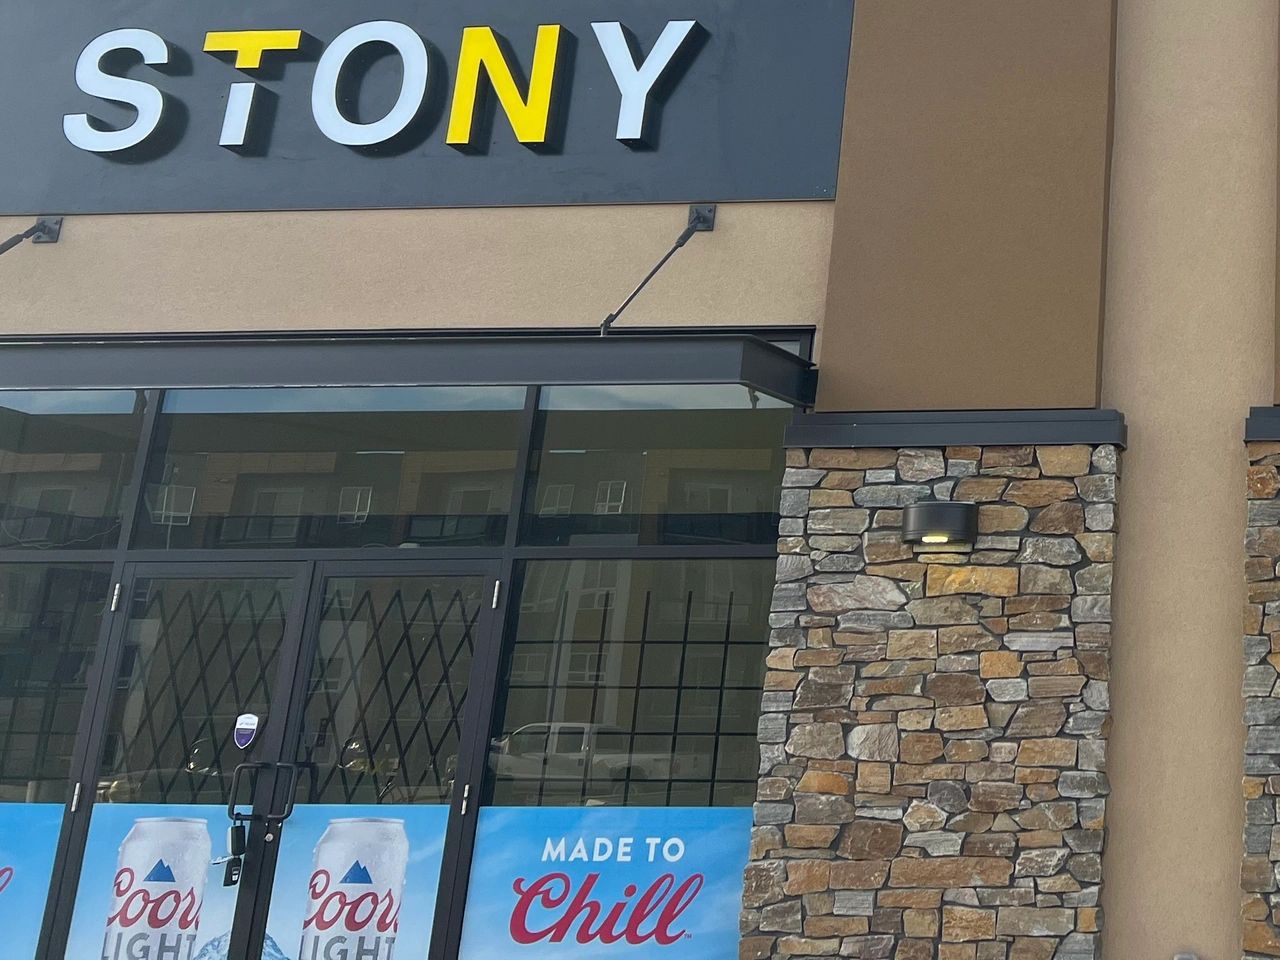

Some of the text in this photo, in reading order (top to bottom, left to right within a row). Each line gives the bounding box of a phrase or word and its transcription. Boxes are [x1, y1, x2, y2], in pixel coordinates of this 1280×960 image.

[62, 19, 704, 154] STONY
[541, 837, 685, 862] MADE TO
[107, 867, 203, 931] Coor
[303, 869, 402, 933] Coor
[509, 872, 705, 945] Chill
